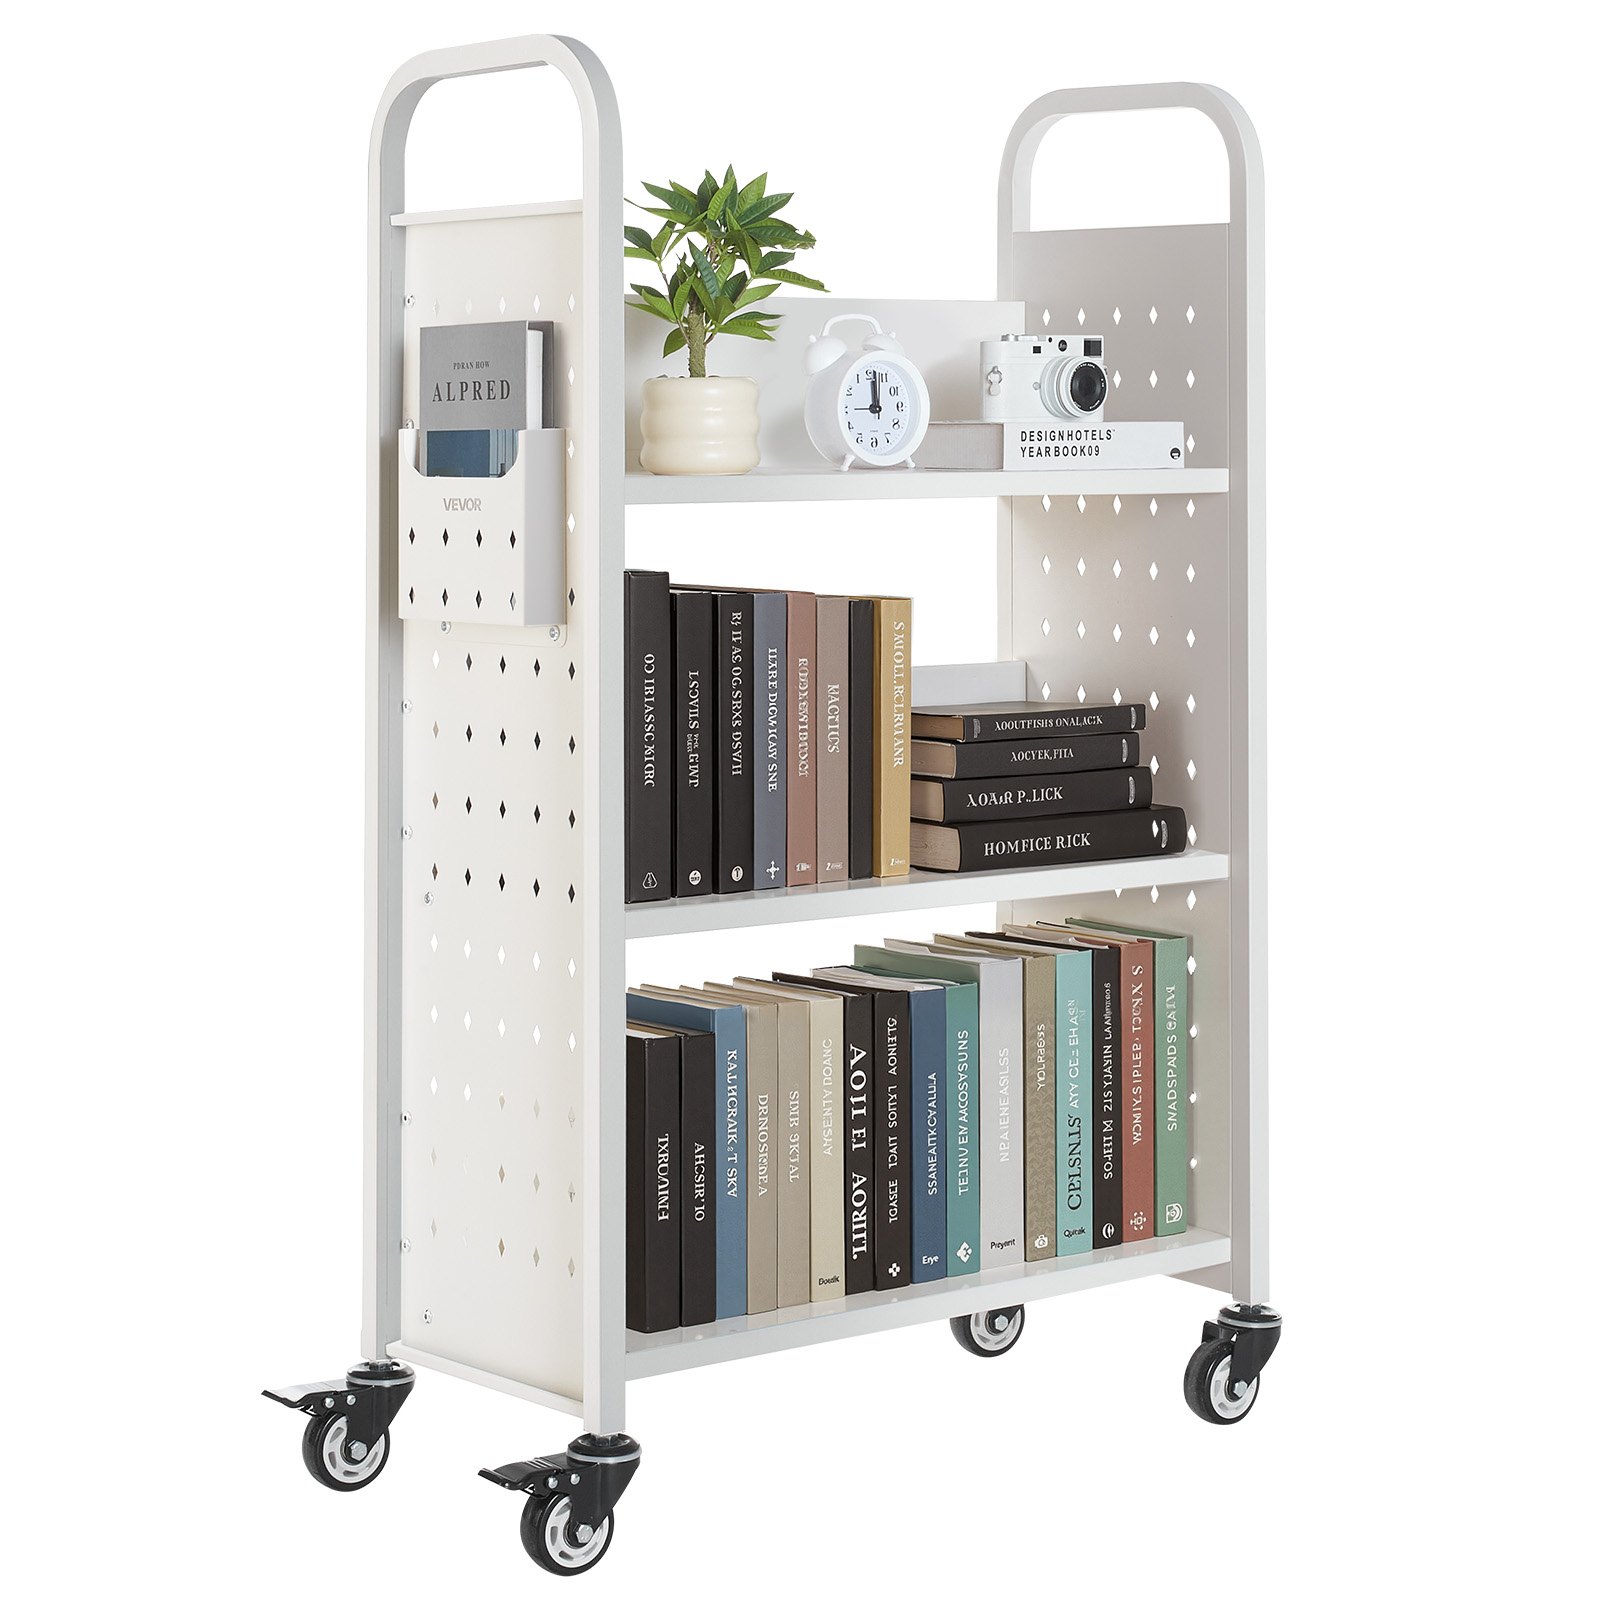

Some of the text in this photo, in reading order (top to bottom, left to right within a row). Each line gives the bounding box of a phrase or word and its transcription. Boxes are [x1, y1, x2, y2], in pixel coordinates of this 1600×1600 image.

[432, 380, 511, 402] ALPRED
[443, 498, 482, 511] VEVOR
[983, 832, 1091, 857] HOMFICE RICK
